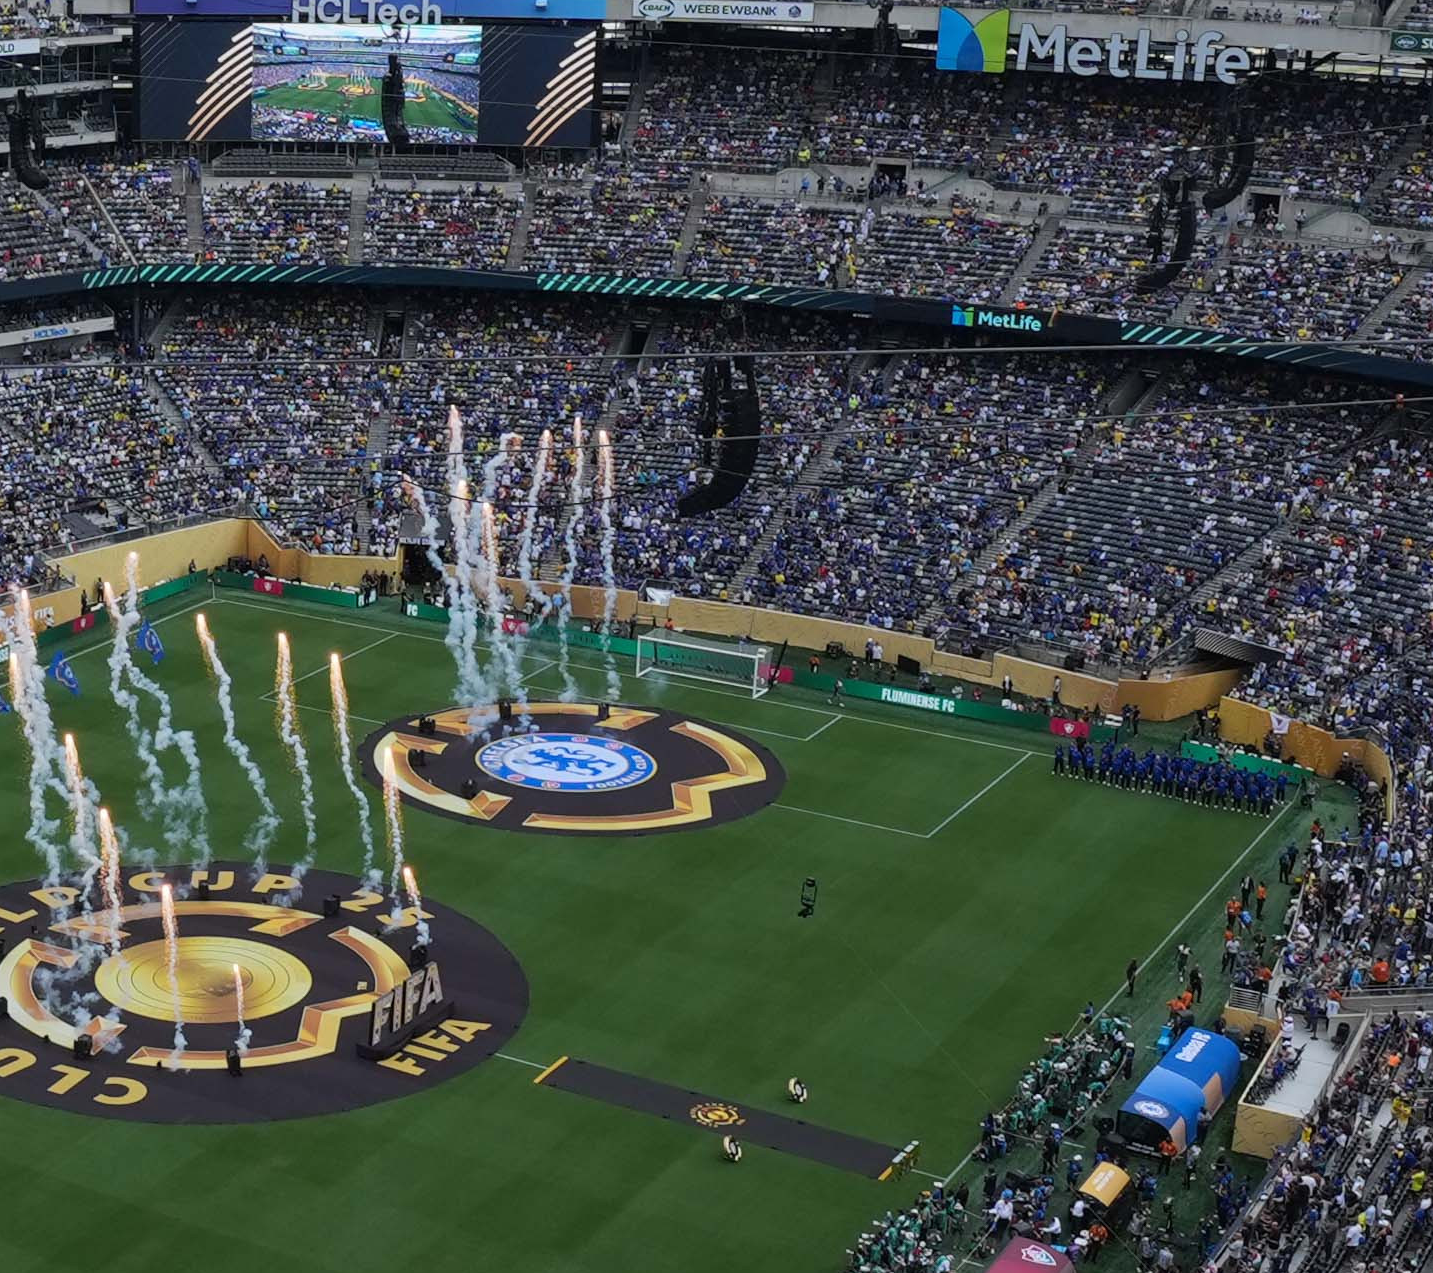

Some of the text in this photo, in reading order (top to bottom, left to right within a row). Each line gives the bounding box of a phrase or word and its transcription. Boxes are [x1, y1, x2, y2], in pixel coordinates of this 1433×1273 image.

[684, 5, 777, 17] WEEB EWBANK
[1016, 23, 1250, 85] MetLife
[34, 327, 69, 338] HCLTech
[978, 311, 1042, 331] MetLife
[406, 604, 418, 617] FC
[881, 687, 955, 713] FLUMINENSE FC
[128, 870, 303, 898] CUP
[370, 960, 444, 1047] FIFA
[377, 1017, 492, 1077] FIFA
[1175, 1031, 1212, 1063] Chelsea FC
